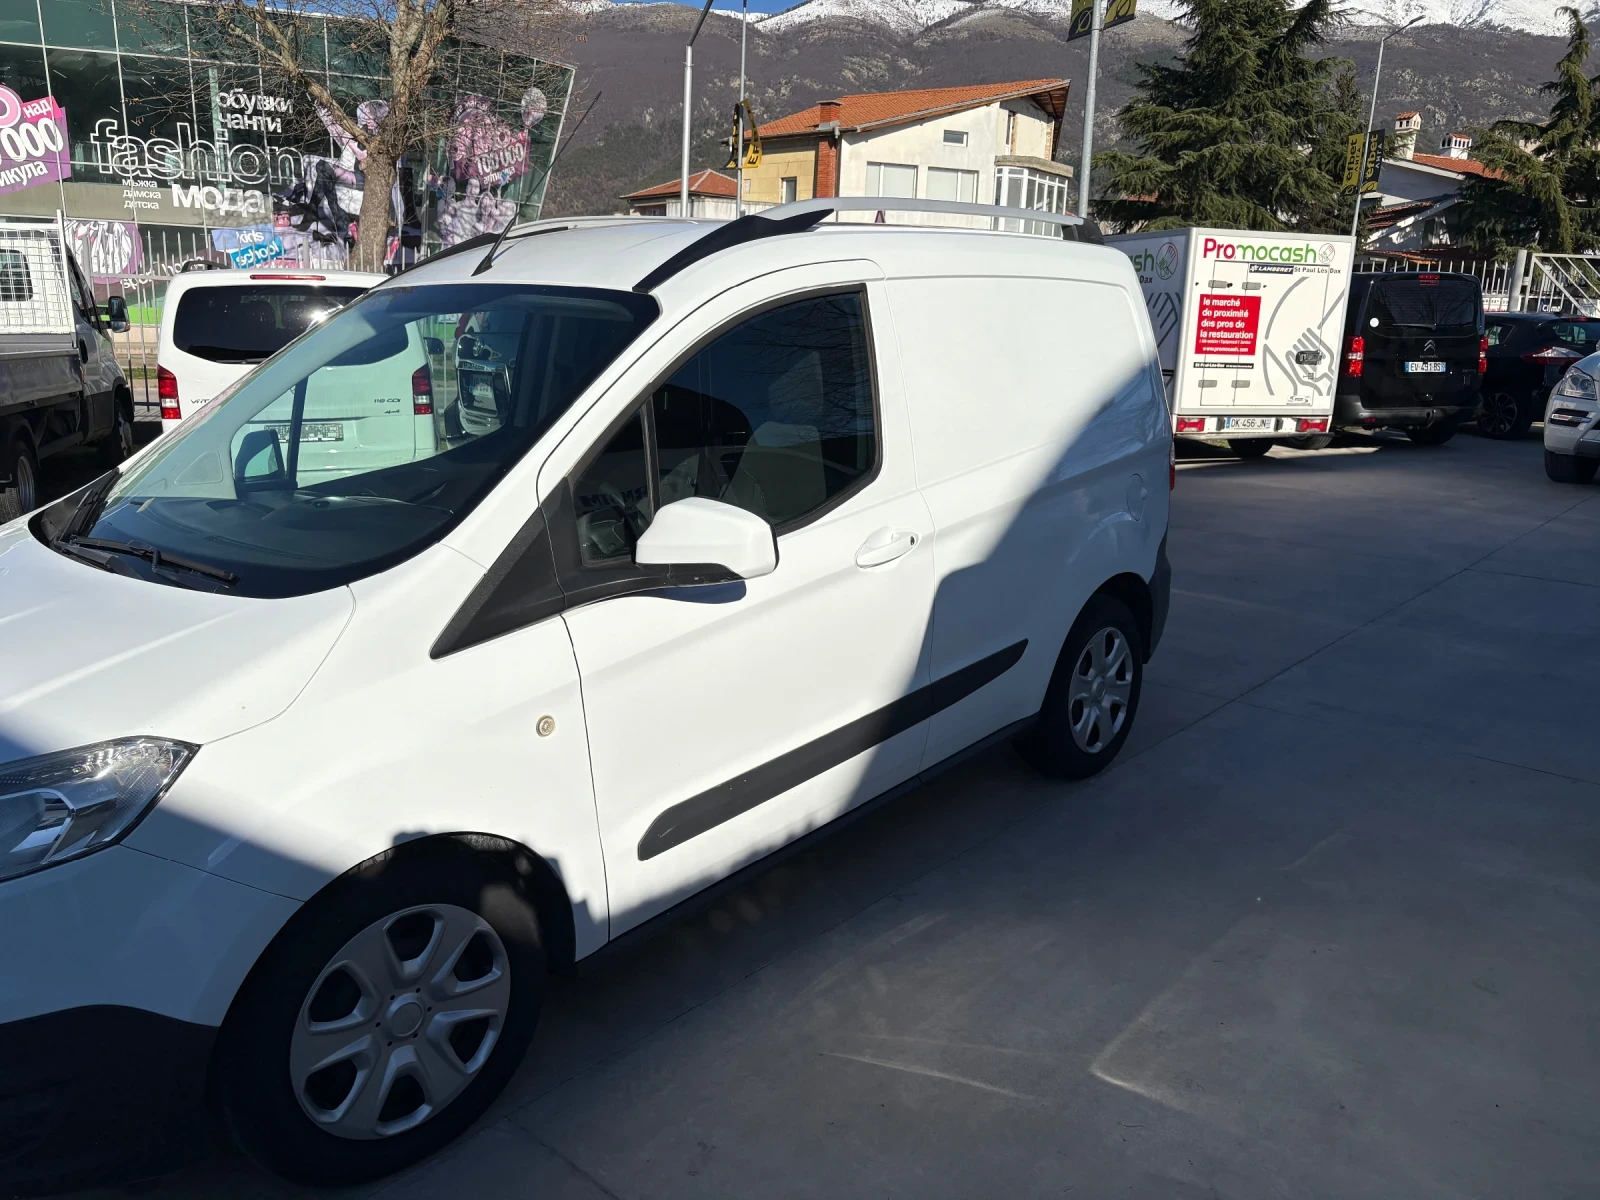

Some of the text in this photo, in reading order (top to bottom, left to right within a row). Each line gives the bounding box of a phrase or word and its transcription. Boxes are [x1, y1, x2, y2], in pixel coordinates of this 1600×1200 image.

[23, 99, 52, 118] над
[217, 88, 293, 114] обувки
[218, 112, 282, 133] чанти
[90, 118, 304, 186] fashion
[1346, 139, 1357, 182] efbet
[1366, 133, 1378, 179] efbet
[236, 229, 265, 244] kids
[236, 241, 280, 266] school
[1203, 238, 1316, 264] Promocash
[1258, 265, 1293, 274] LAMBERET
[1203, 297, 1241, 307] le marché
[1202, 308, 1249, 318] de proximité
[1199, 329, 1254, 339] la restauration
[1200, 319, 1245, 329] des pros de
